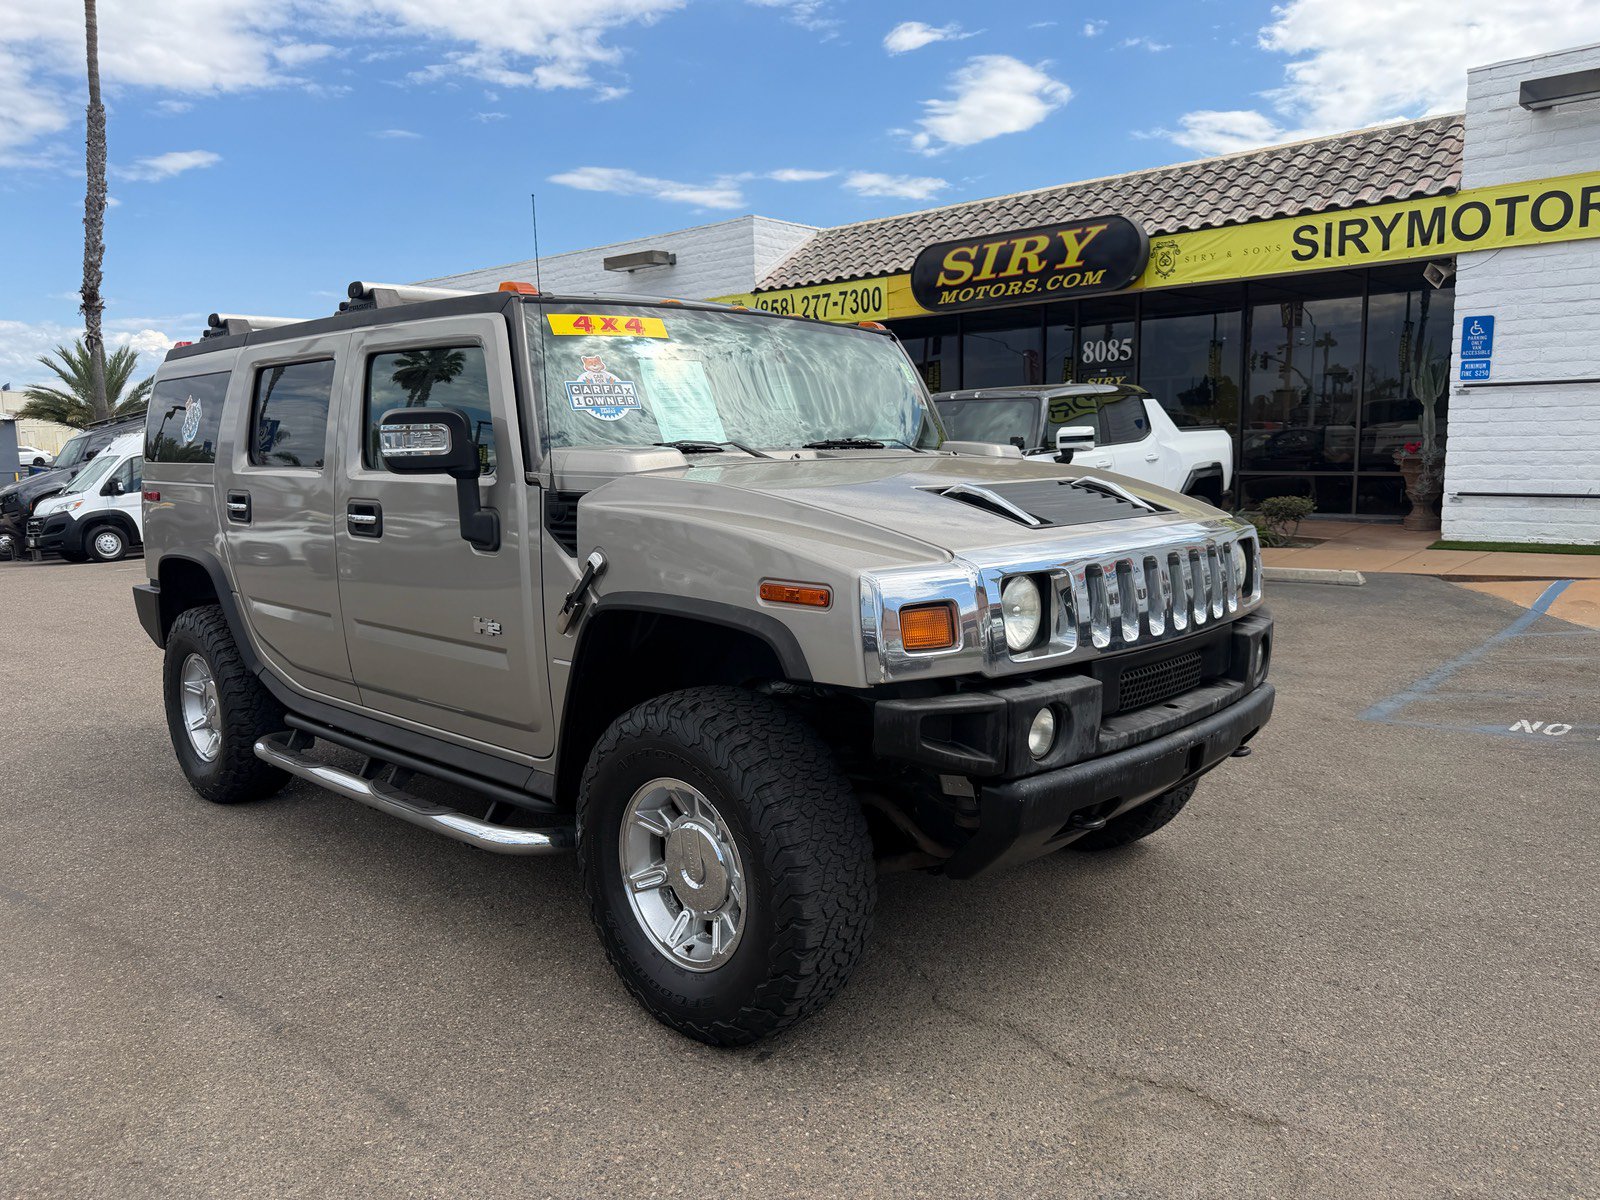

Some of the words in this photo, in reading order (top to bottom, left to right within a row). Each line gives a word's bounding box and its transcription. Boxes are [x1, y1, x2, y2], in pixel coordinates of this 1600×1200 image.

[1291, 185, 1600, 261] SIRYMOTOR
[935, 223, 1110, 287] SIRY
[1184, 252, 1217, 264] SIRY
[1226, 250, 1233, 258] &
[1243, 244, 1281, 256] SONS
[937, 269, 1107, 305] MOTORS.COM
[801, 286, 882, 321] 277-7300
[1082, 338, 1133, 364] 8085
[571, 385, 632, 395] CARFAX
[585, 397, 636, 405] OWNER
[472, 615, 502, 636] H2
[1508, 719, 1573, 736] NO
